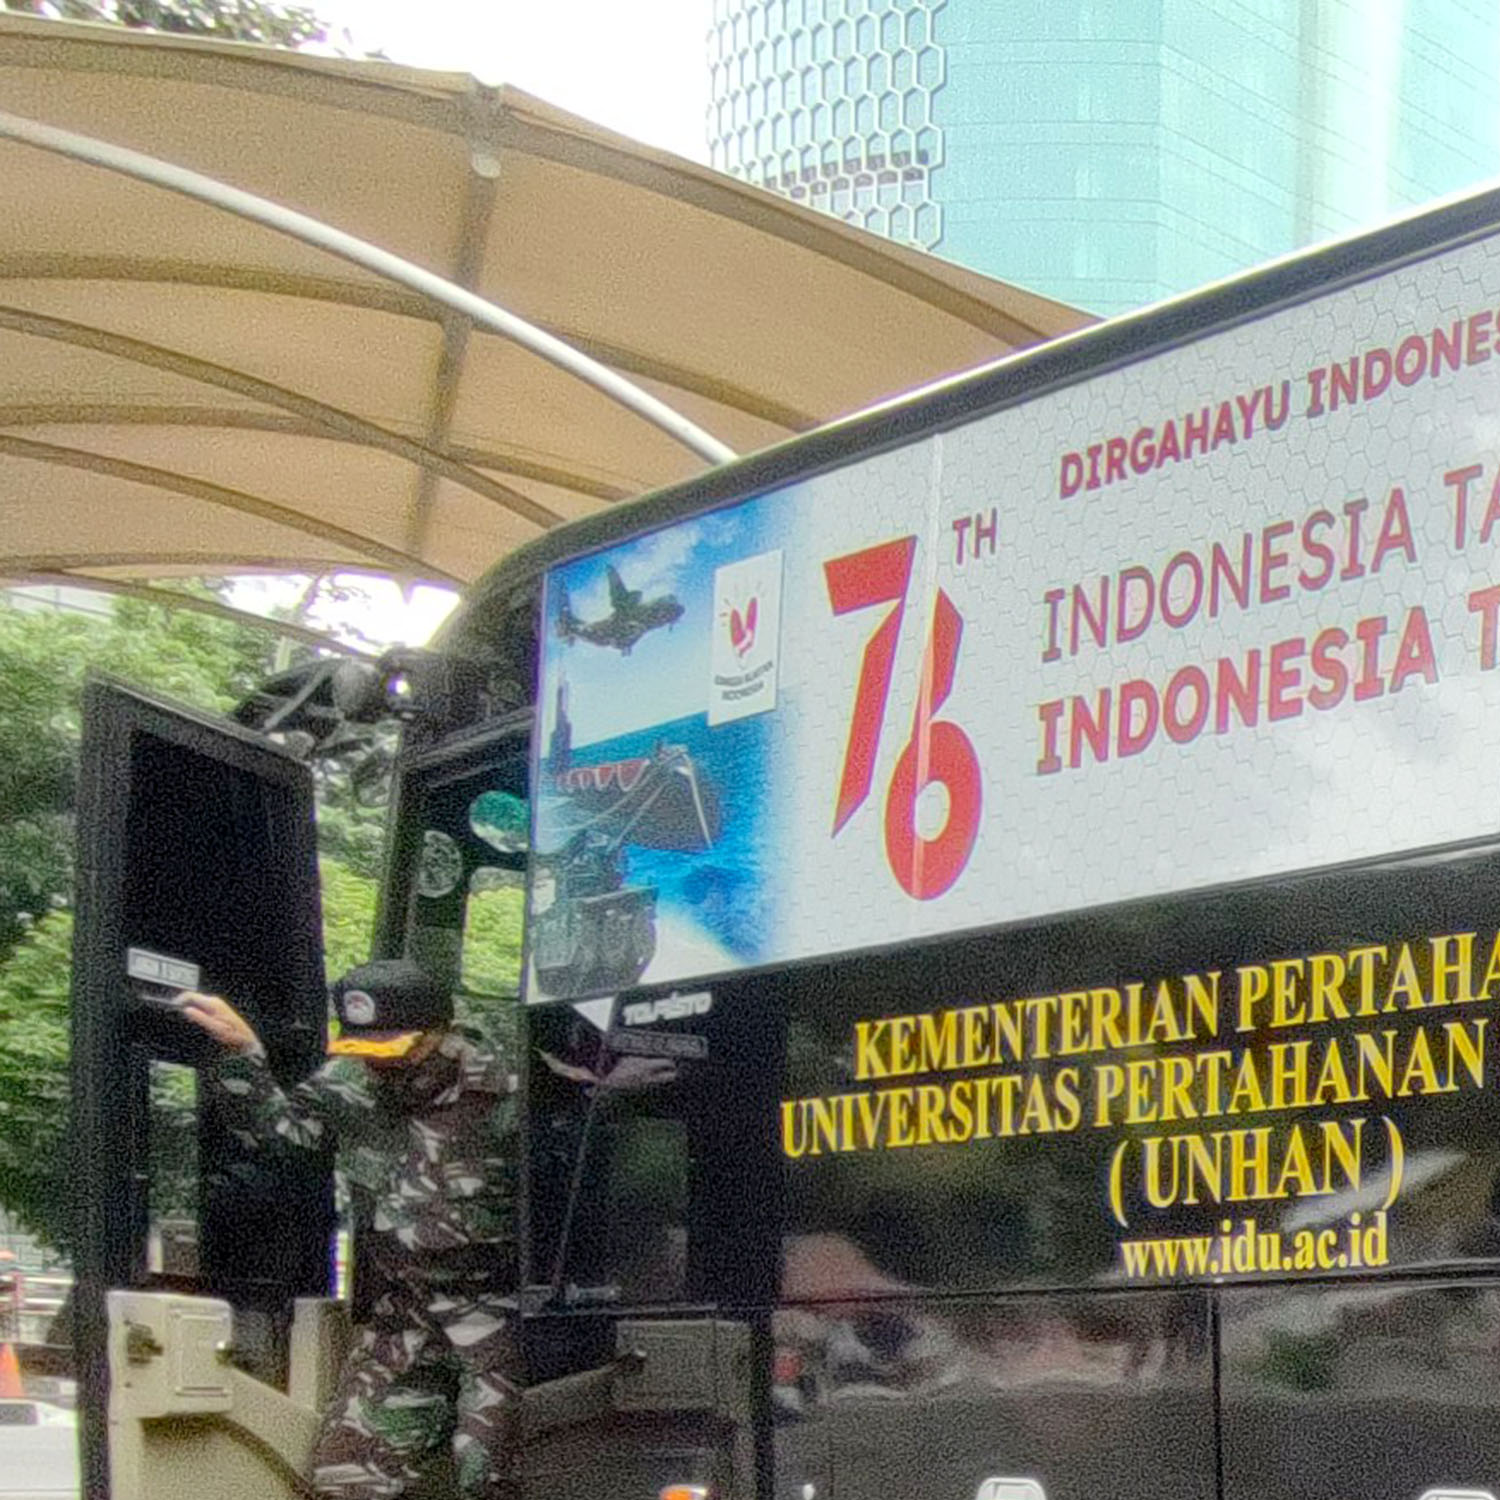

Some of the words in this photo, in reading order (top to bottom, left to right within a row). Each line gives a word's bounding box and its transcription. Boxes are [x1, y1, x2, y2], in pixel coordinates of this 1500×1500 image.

[1058, 379, 1290, 498] DIRGAHAYU
[1041, 488, 1414, 664] INDONESIA
[822, 535, 983, 903] 76
[952, 508, 998, 566] TH
[1036, 606, 1438, 776] INDONESIA
[780, 1065, 1082, 1159] UNIVERSITAS
[1092, 1016, 1488, 1128] PERTAHANAN
[854, 971, 1220, 1081] KEMENTERIAN
[1120, 1211, 1391, 1278] www.idu.ac.id
